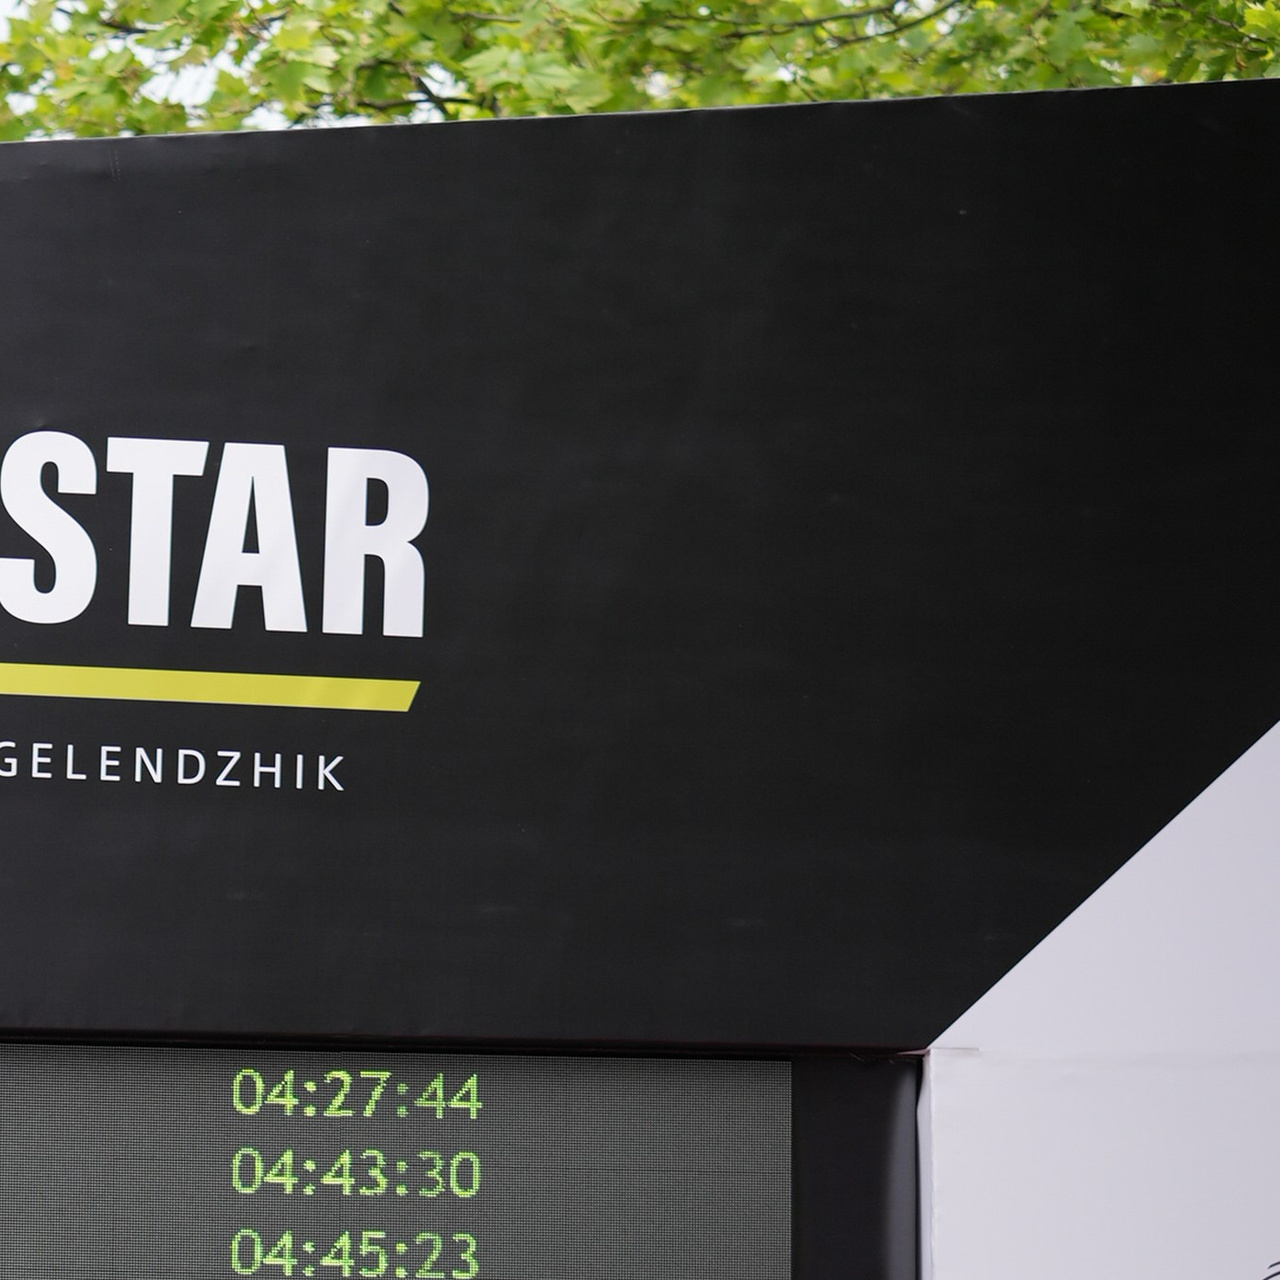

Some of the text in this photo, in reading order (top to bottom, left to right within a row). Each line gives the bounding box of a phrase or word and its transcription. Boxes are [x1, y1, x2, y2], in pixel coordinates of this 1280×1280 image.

[232, 1068, 483, 1119] 04:27:44
[231, 1147, 481, 1197] 04:43:30
[230, 1229, 479, 1279] 04:45:23
